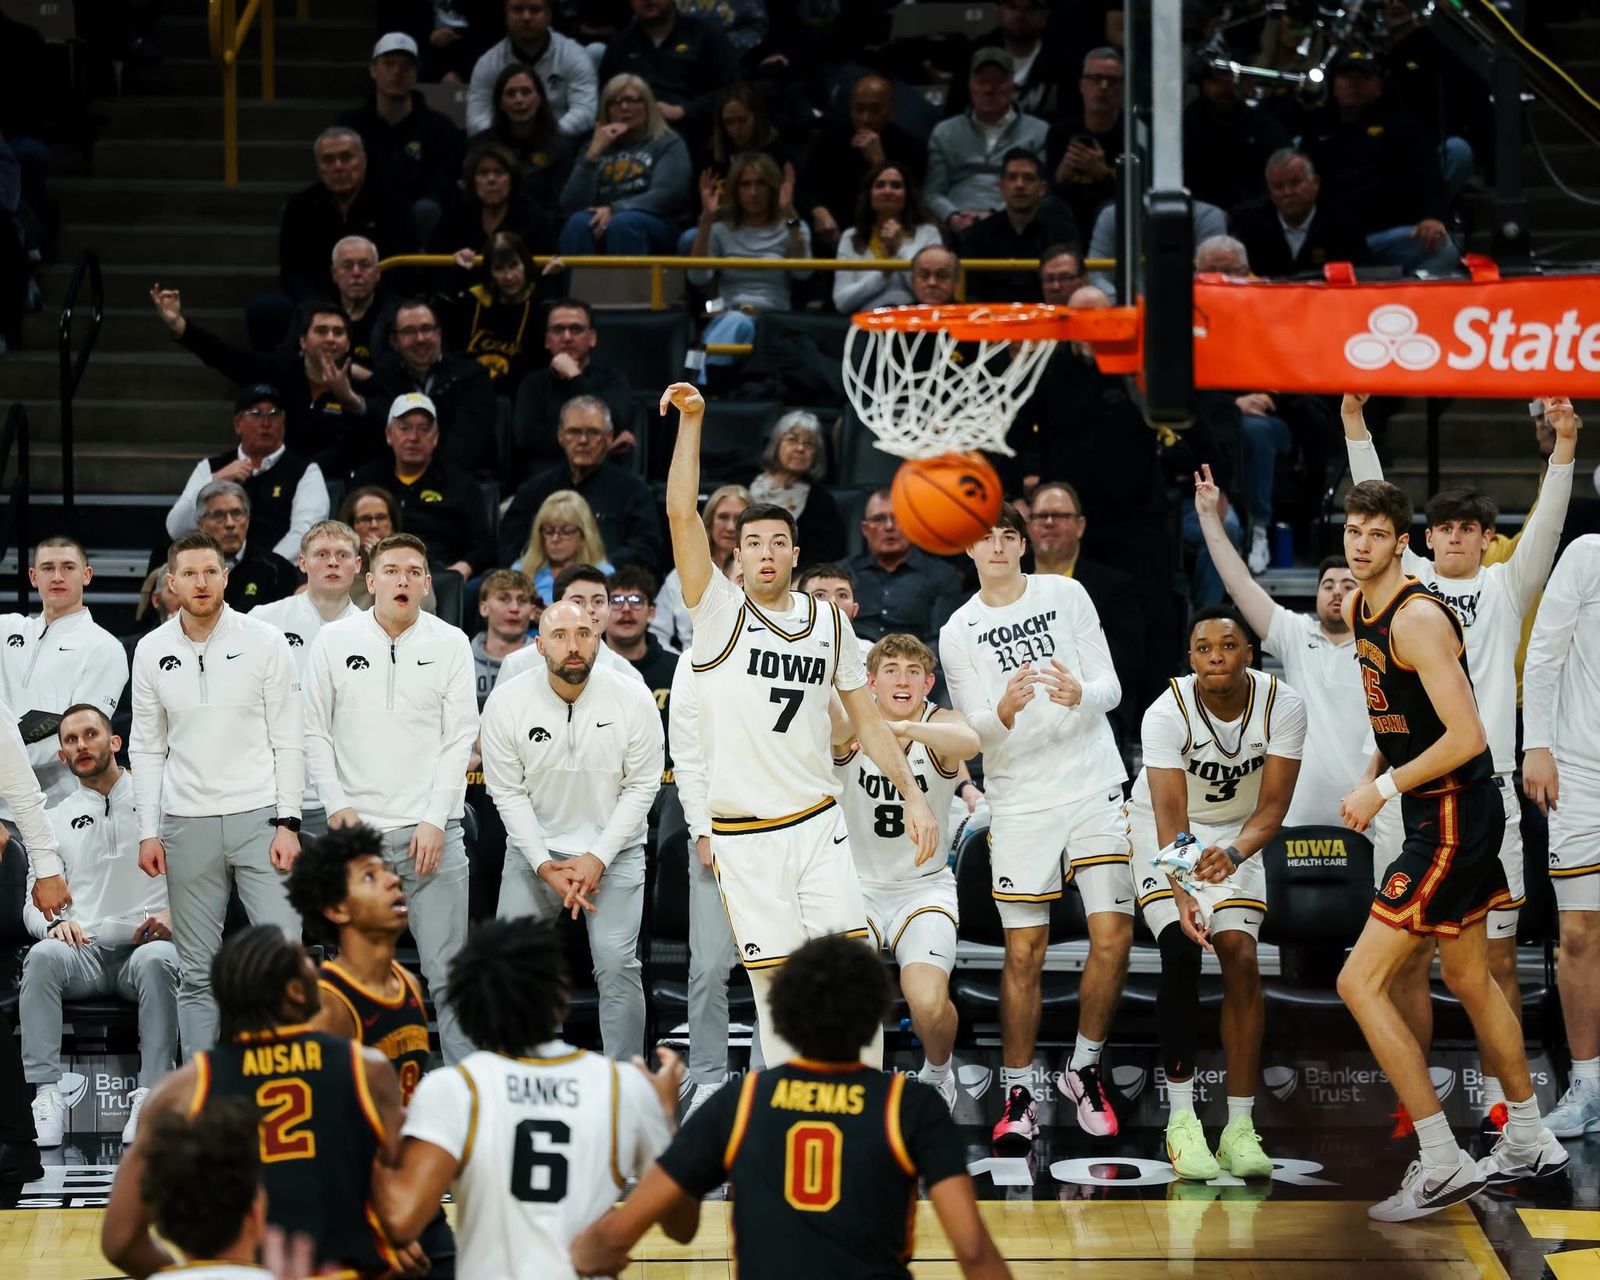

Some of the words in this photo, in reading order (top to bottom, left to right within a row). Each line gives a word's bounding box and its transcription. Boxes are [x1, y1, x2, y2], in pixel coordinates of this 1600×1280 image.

[1448, 306, 1600, 372] State
[746, 647, 827, 686] IOWA
[769, 686, 806, 734] 7
[1186, 755, 1266, 781] IOWA
[1205, 778, 1241, 804] 3
[874, 804, 906, 839] 8
[1285, 838, 1348, 858] IOWA
[1287, 858, 1322, 868] HEALTH
[1323, 857, 1348, 867] CARE
[242, 1040, 323, 1077] AUSAR
[506, 1074, 580, 1108] BANKS
[769, 1077, 866, 1116] ARENAS
[256, 1077, 317, 1164] 2
[510, 1118, 571, 1204] 6
[784, 1119, 844, 1213] 0
